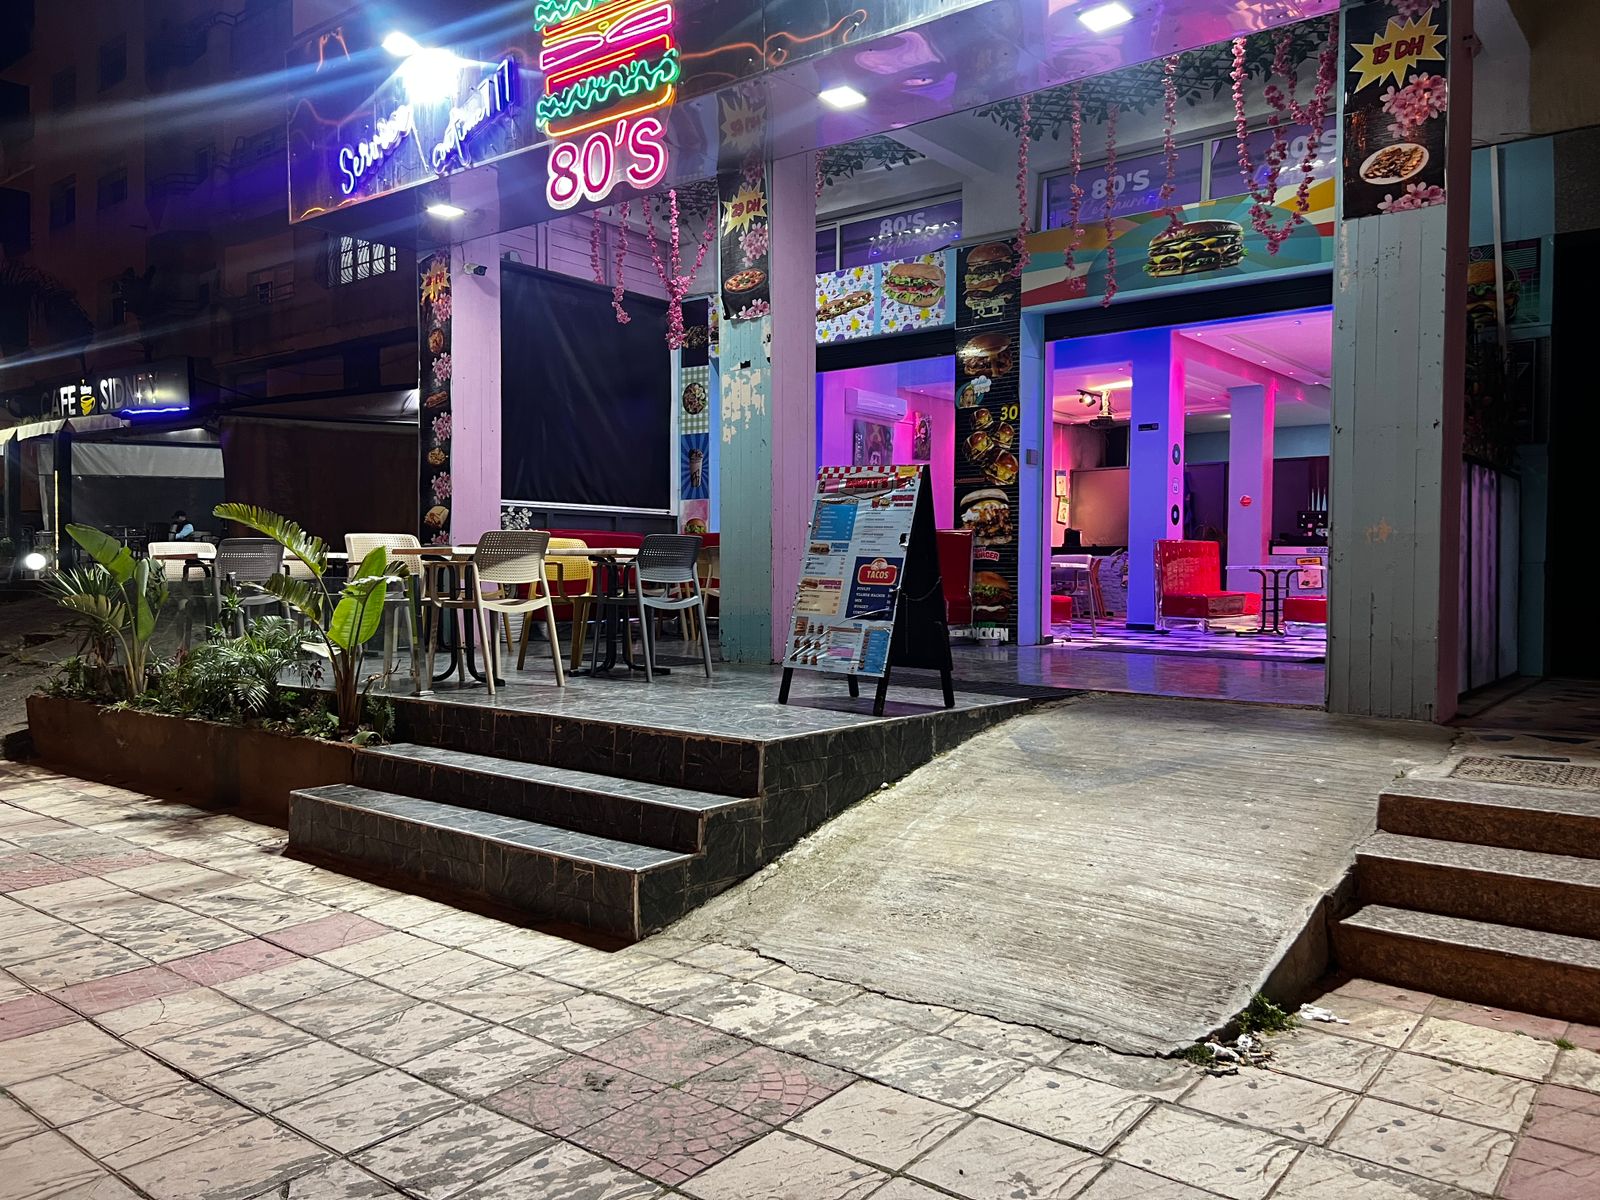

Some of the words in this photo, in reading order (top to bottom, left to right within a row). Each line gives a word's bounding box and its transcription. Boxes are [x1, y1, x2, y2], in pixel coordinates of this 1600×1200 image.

[1372, 42, 1391, 65] 15
[1394, 35, 1425, 61] DH
[547, 117, 666, 208] 80'S
[1091, 170, 1150, 199] 80'S
[745, 198, 761, 215] DH
[880, 212, 927, 238] 80'S
[40, 384, 77, 417] CAFE
[999, 405, 1019, 421] 30
[867, 570, 889, 579] TACOS
